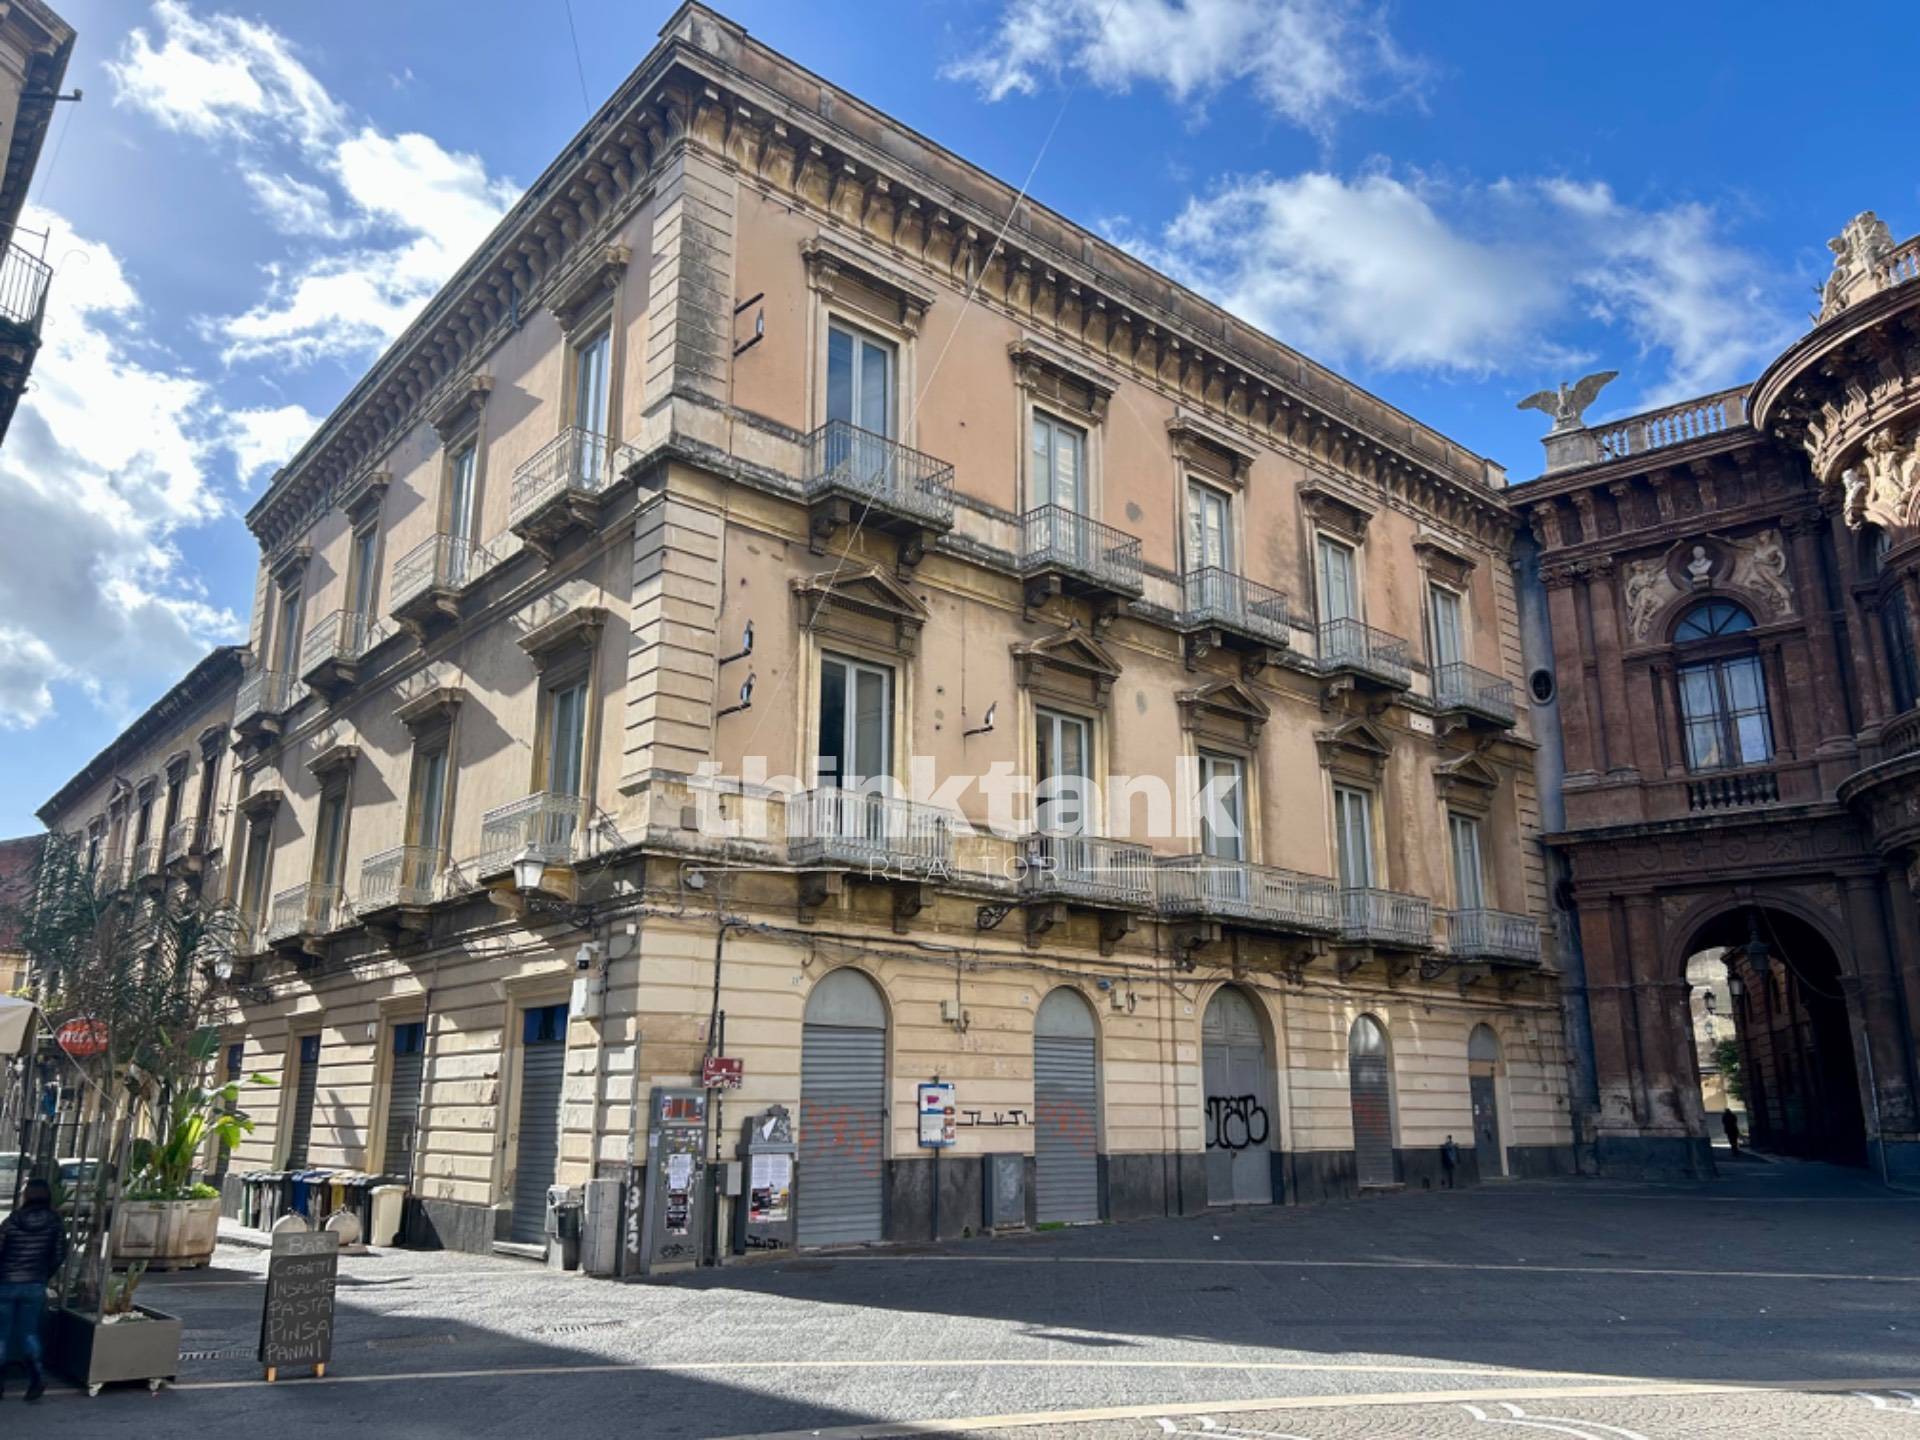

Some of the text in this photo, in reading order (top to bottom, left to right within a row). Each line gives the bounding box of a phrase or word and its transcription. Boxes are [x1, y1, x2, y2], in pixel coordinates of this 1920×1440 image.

[287, 1236, 330, 1255] BAR
[268, 1297, 332, 1317] PASTA
[269, 1319, 330, 1341] PINSA
[265, 1340, 322, 1361] PANINI
